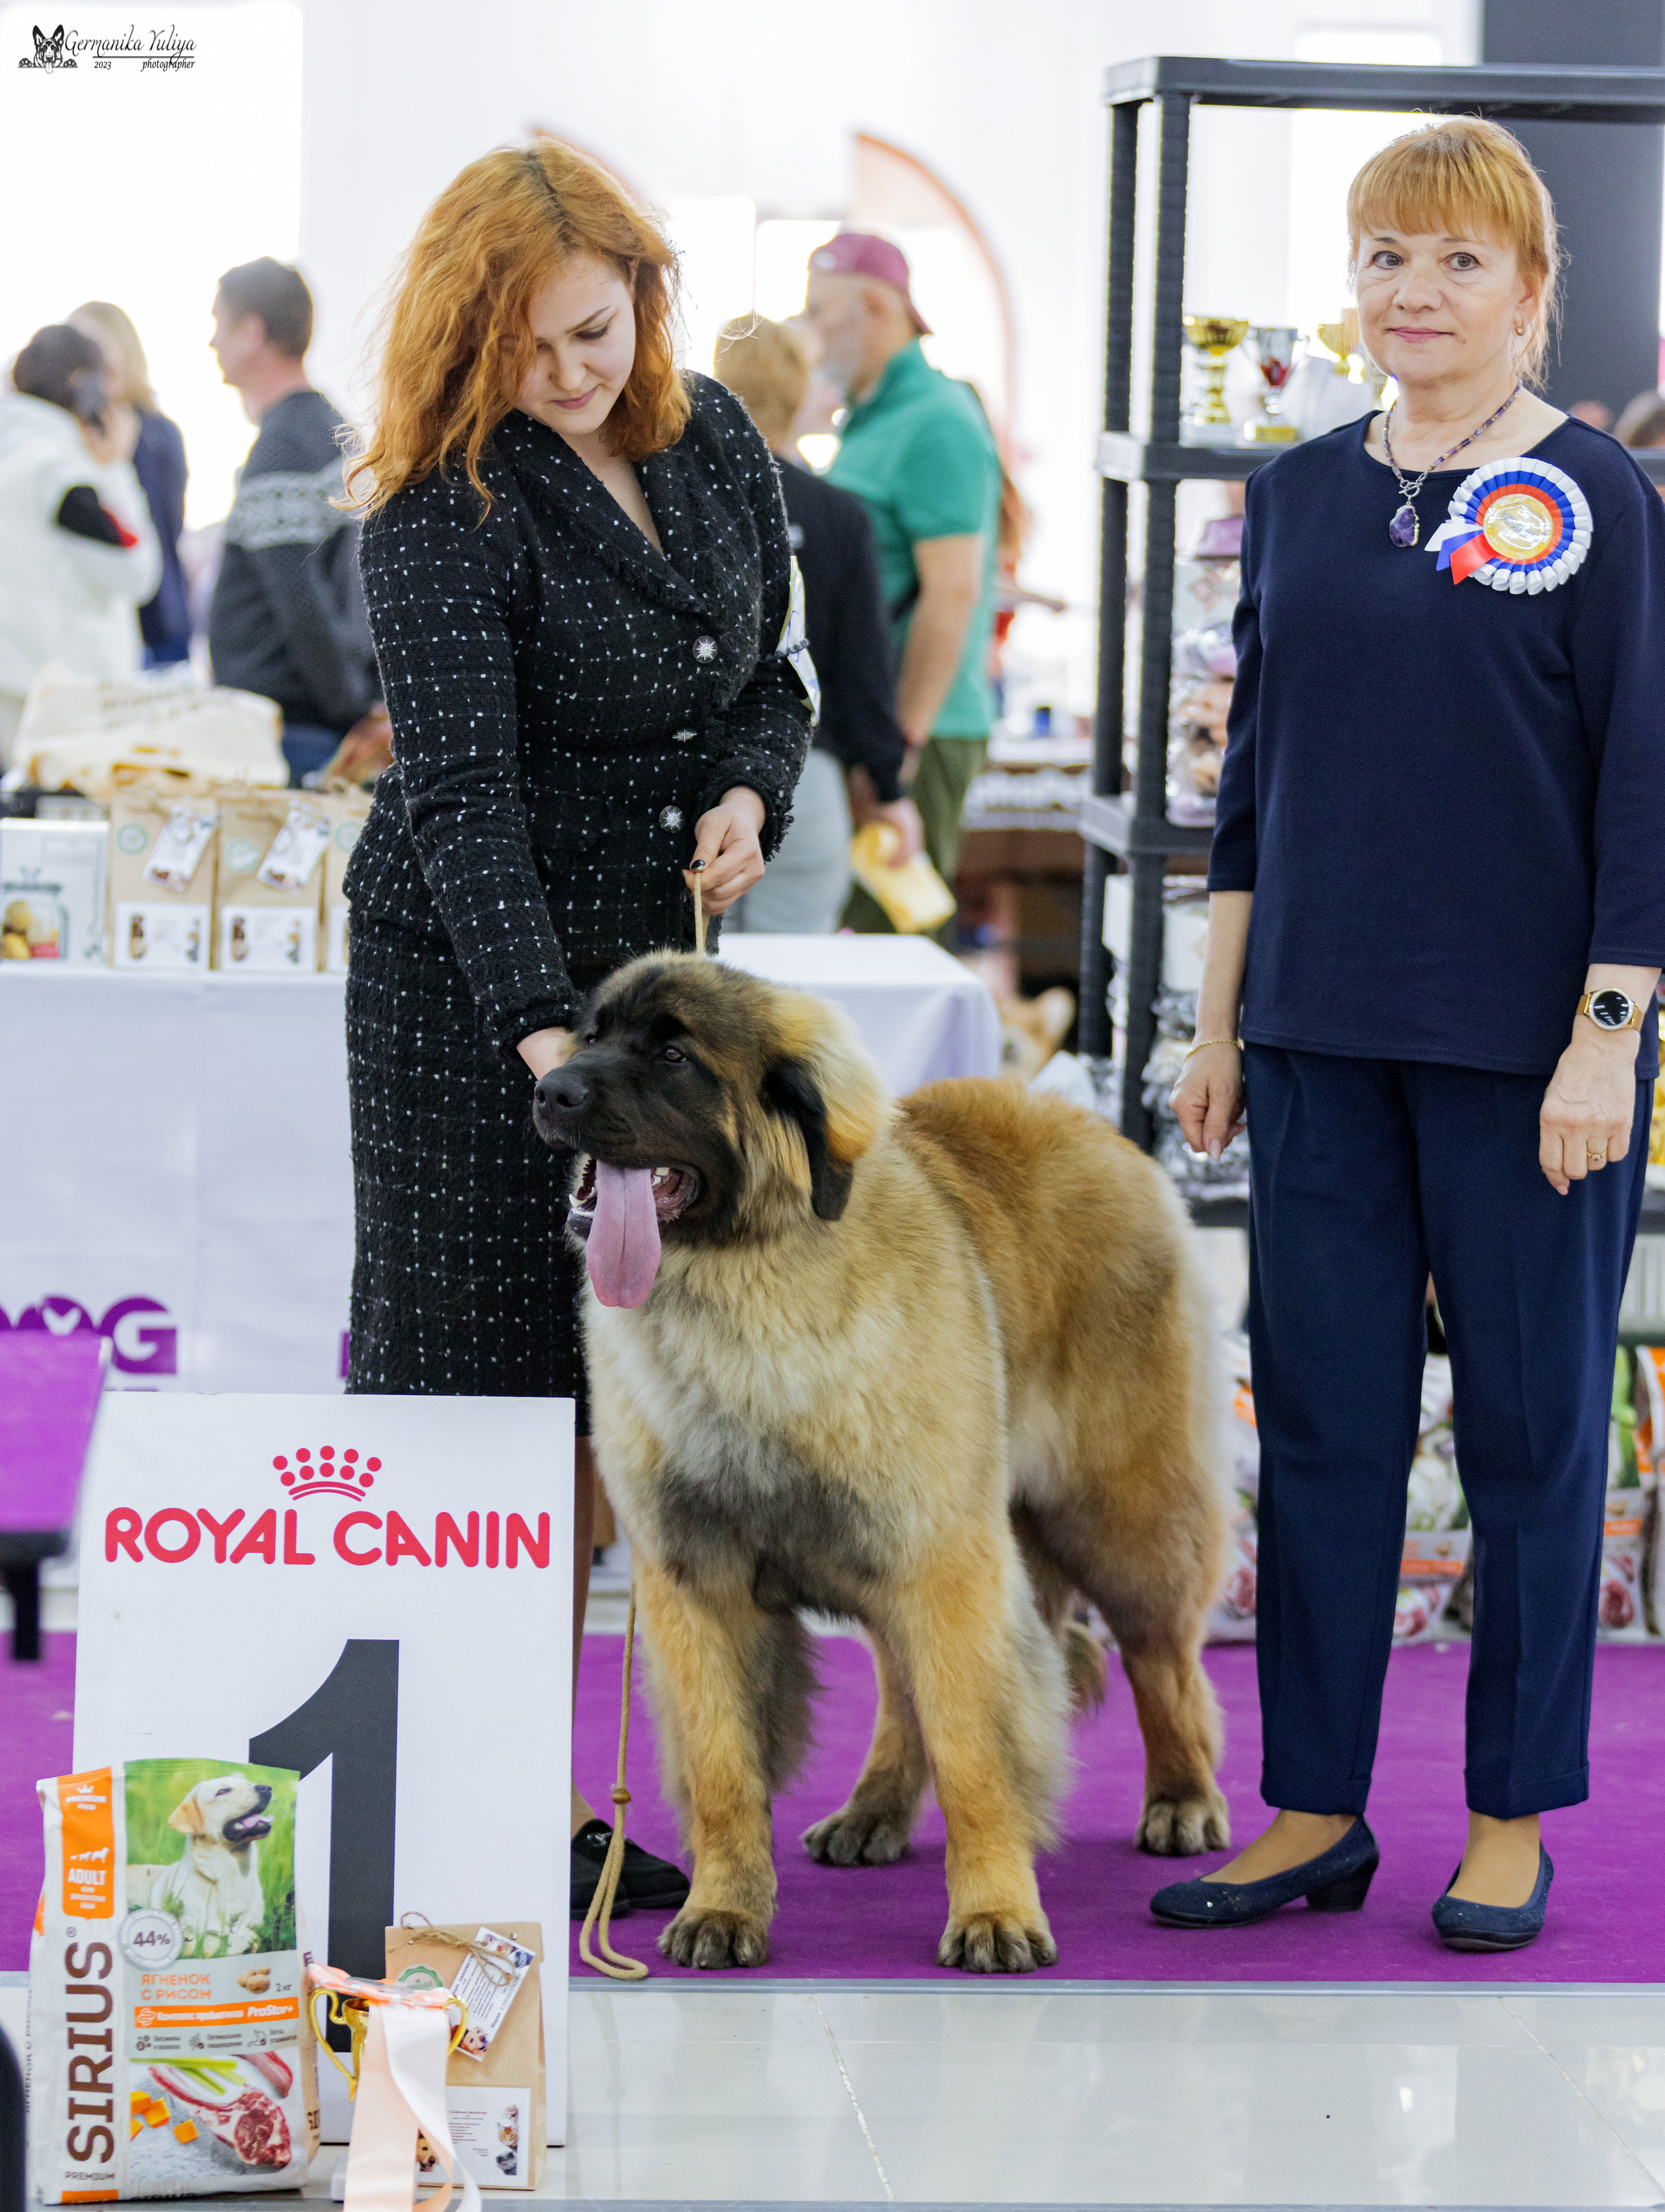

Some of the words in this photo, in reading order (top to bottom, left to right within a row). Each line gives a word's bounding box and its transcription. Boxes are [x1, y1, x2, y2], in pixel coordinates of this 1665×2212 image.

[105, 1507, 315, 1565] ROYAL
[333, 1510, 550, 1569] CANIN
[249, 1639, 399, 2053] 1
[68, 1868, 107, 1886] ADULT
[133, 1930, 170, 1947] 44%
[140, 1973, 210, 1986] ЯГНЕНОК
[140, 1990, 152, 2001] С
[155, 1988, 211, 2001] РИСОМ
[65, 1941, 114, 2163] SIRIUS
[65, 2171, 116, 2180] PREMIUM
